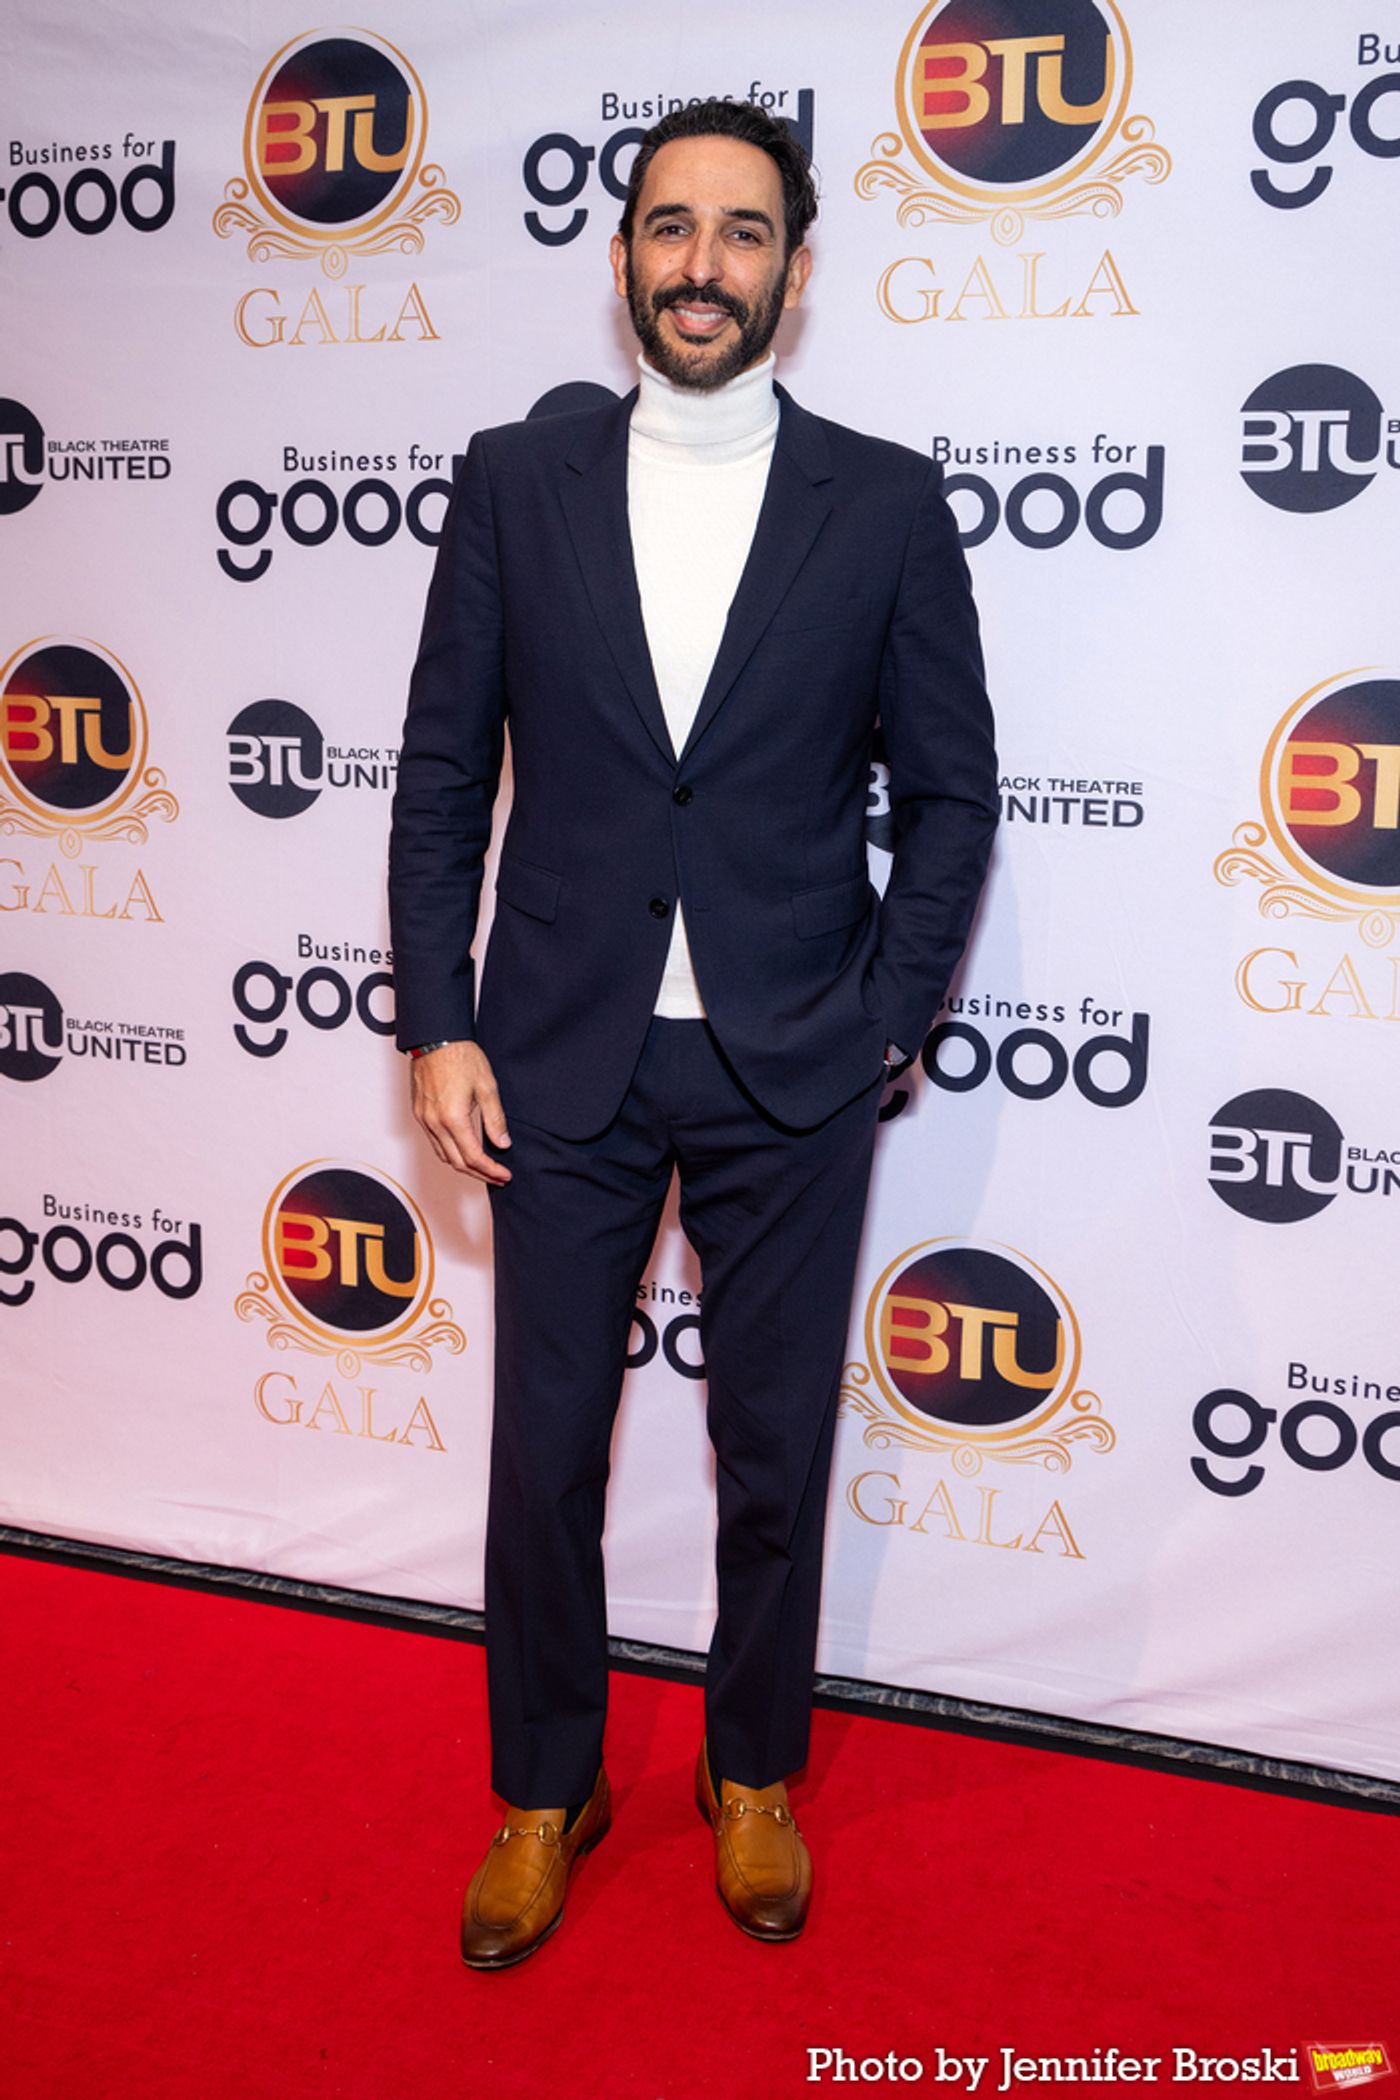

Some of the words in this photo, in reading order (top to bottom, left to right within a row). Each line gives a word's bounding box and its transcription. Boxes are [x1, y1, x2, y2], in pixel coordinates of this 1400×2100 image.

[747, 81, 789, 111] for
[911, 33, 1114, 131] BTU
[9, 140, 112, 166] Business
[123, 132, 156, 158] for
[256, 91, 413, 177] BTU
[1250, 72, 1400, 210] go
[0, 140, 176, 239] ood
[234, 282, 440, 347] GALA
[875, 249, 1140, 324] GALA
[0, 433, 44, 486] TU
[48, 440, 96, 453] BLACK
[101, 439, 169, 451] THEATRE
[49, 456, 171, 481] UNITED
[283, 446, 397, 472] Business
[409, 444, 444, 471] for
[933, 436, 1077, 465] Business
[1092, 434, 1137, 463] for
[1239, 409, 1384, 475] BTU
[943, 444, 1165, 550] ood
[1, 694, 136, 770] BTU
[226, 734, 324, 791] BTU
[327, 746, 380, 761] BLACK
[998, 776, 1041, 791] ACK
[1047, 778, 1143, 795] THEATRE
[999, 795, 1144, 828] NITED
[1278, 740, 1400, 830] BT
[0, 858, 166, 923] GALA
[298, 934, 394, 965] Busines
[232, 960, 398, 1058] goo
[940, 994, 1066, 1023] usiness
[1080, 997, 1124, 1027] for
[1234, 946, 1400, 1021] GA
[66, 1018, 113, 1033] BLACK
[118, 1022, 185, 1041] THEATRE
[67, 1033, 187, 1066] UNITED
[880, 1012, 1150, 1122] ood
[1207, 1125, 1343, 1195] BTU
[1347, 1146, 1400, 1165] BLAC
[43, 1194, 142, 1229] Business
[152, 1209, 182, 1234] for
[0, 1216, 203, 1307] good
[275, 1210, 420, 1298] BTU
[880, 1293, 1066, 1391] BTU
[254, 1371, 447, 1453] GALA
[1288, 1362, 1400, 1402] Busine
[846, 1470, 1087, 1560] GALA
